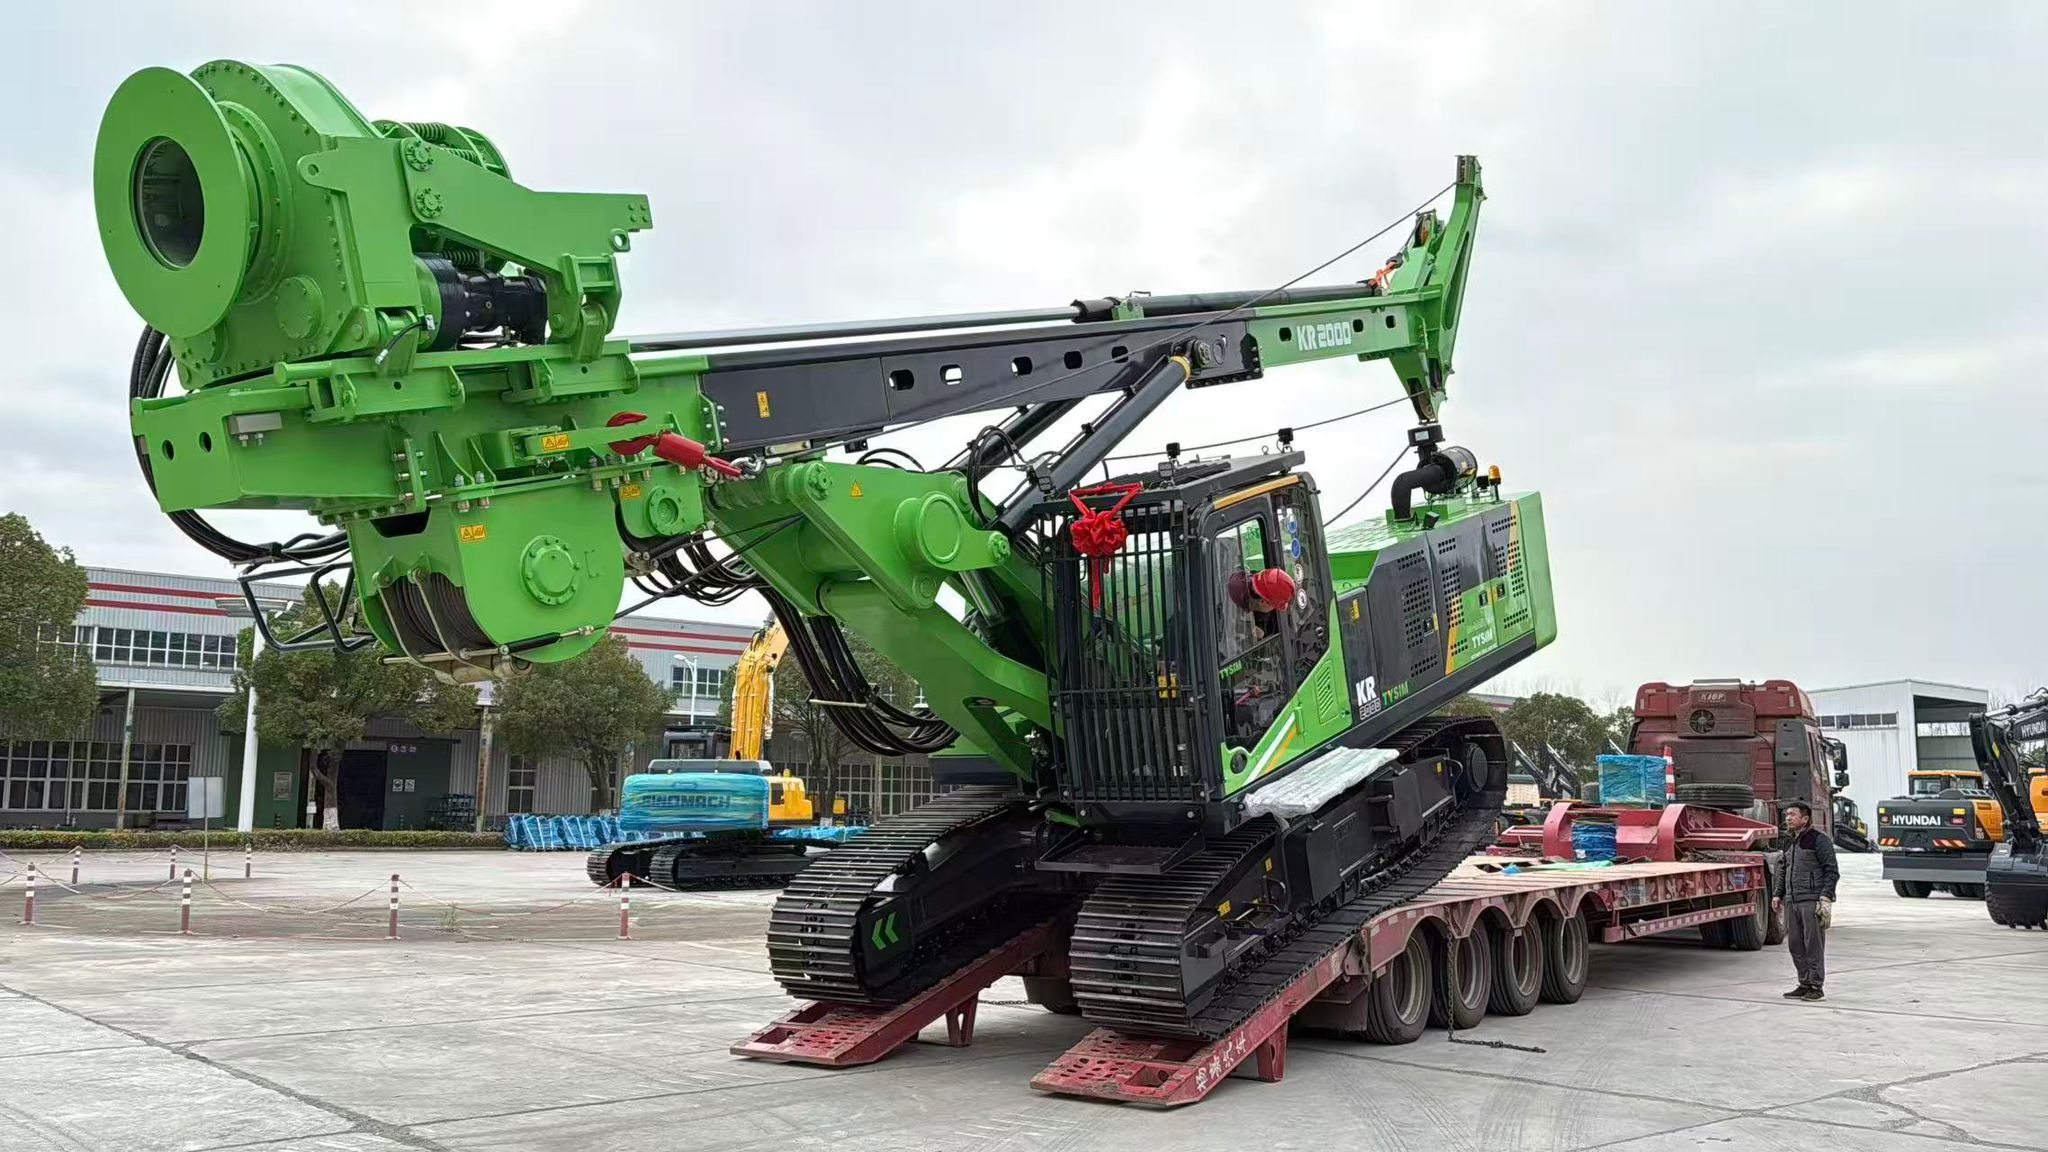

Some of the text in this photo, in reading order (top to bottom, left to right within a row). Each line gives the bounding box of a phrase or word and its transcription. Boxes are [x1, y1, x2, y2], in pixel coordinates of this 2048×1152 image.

[1296, 321, 1352, 351] KR 2000
[1471, 628, 1493, 649] TYSIM
[1219, 659, 1242, 680] TYSIM
[1355, 675, 1377, 707] KR
[1382, 681, 1409, 706] TYSIM
[1892, 815, 1941, 826] HYUNDAI
